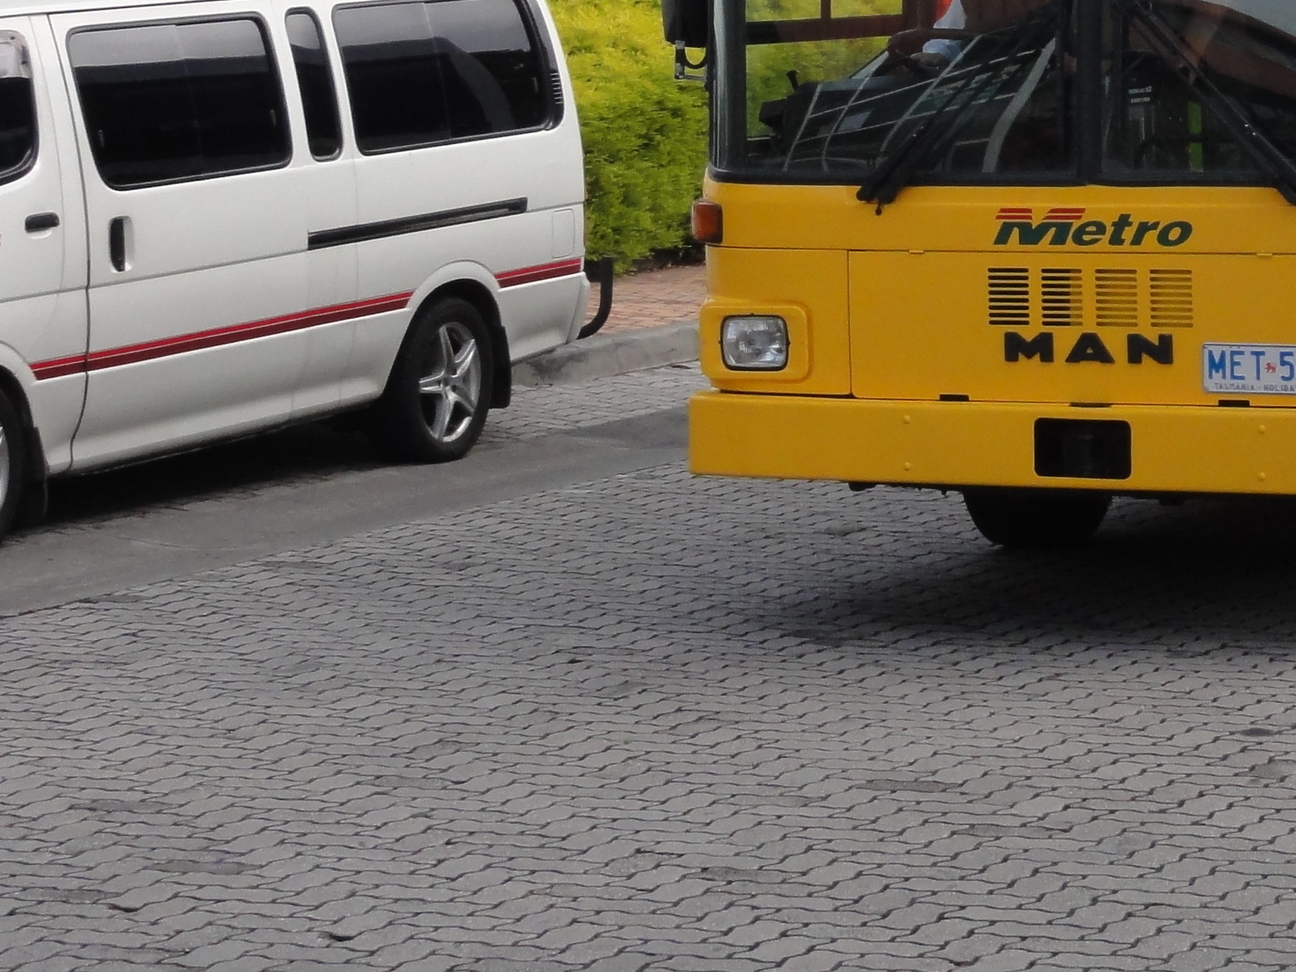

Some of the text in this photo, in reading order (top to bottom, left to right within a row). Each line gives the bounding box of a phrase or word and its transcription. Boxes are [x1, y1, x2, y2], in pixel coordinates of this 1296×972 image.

[993, 207, 1194, 247] Metro
[1004, 331, 1174, 365] MAN
[1207, 349, 1266, 381] MET
